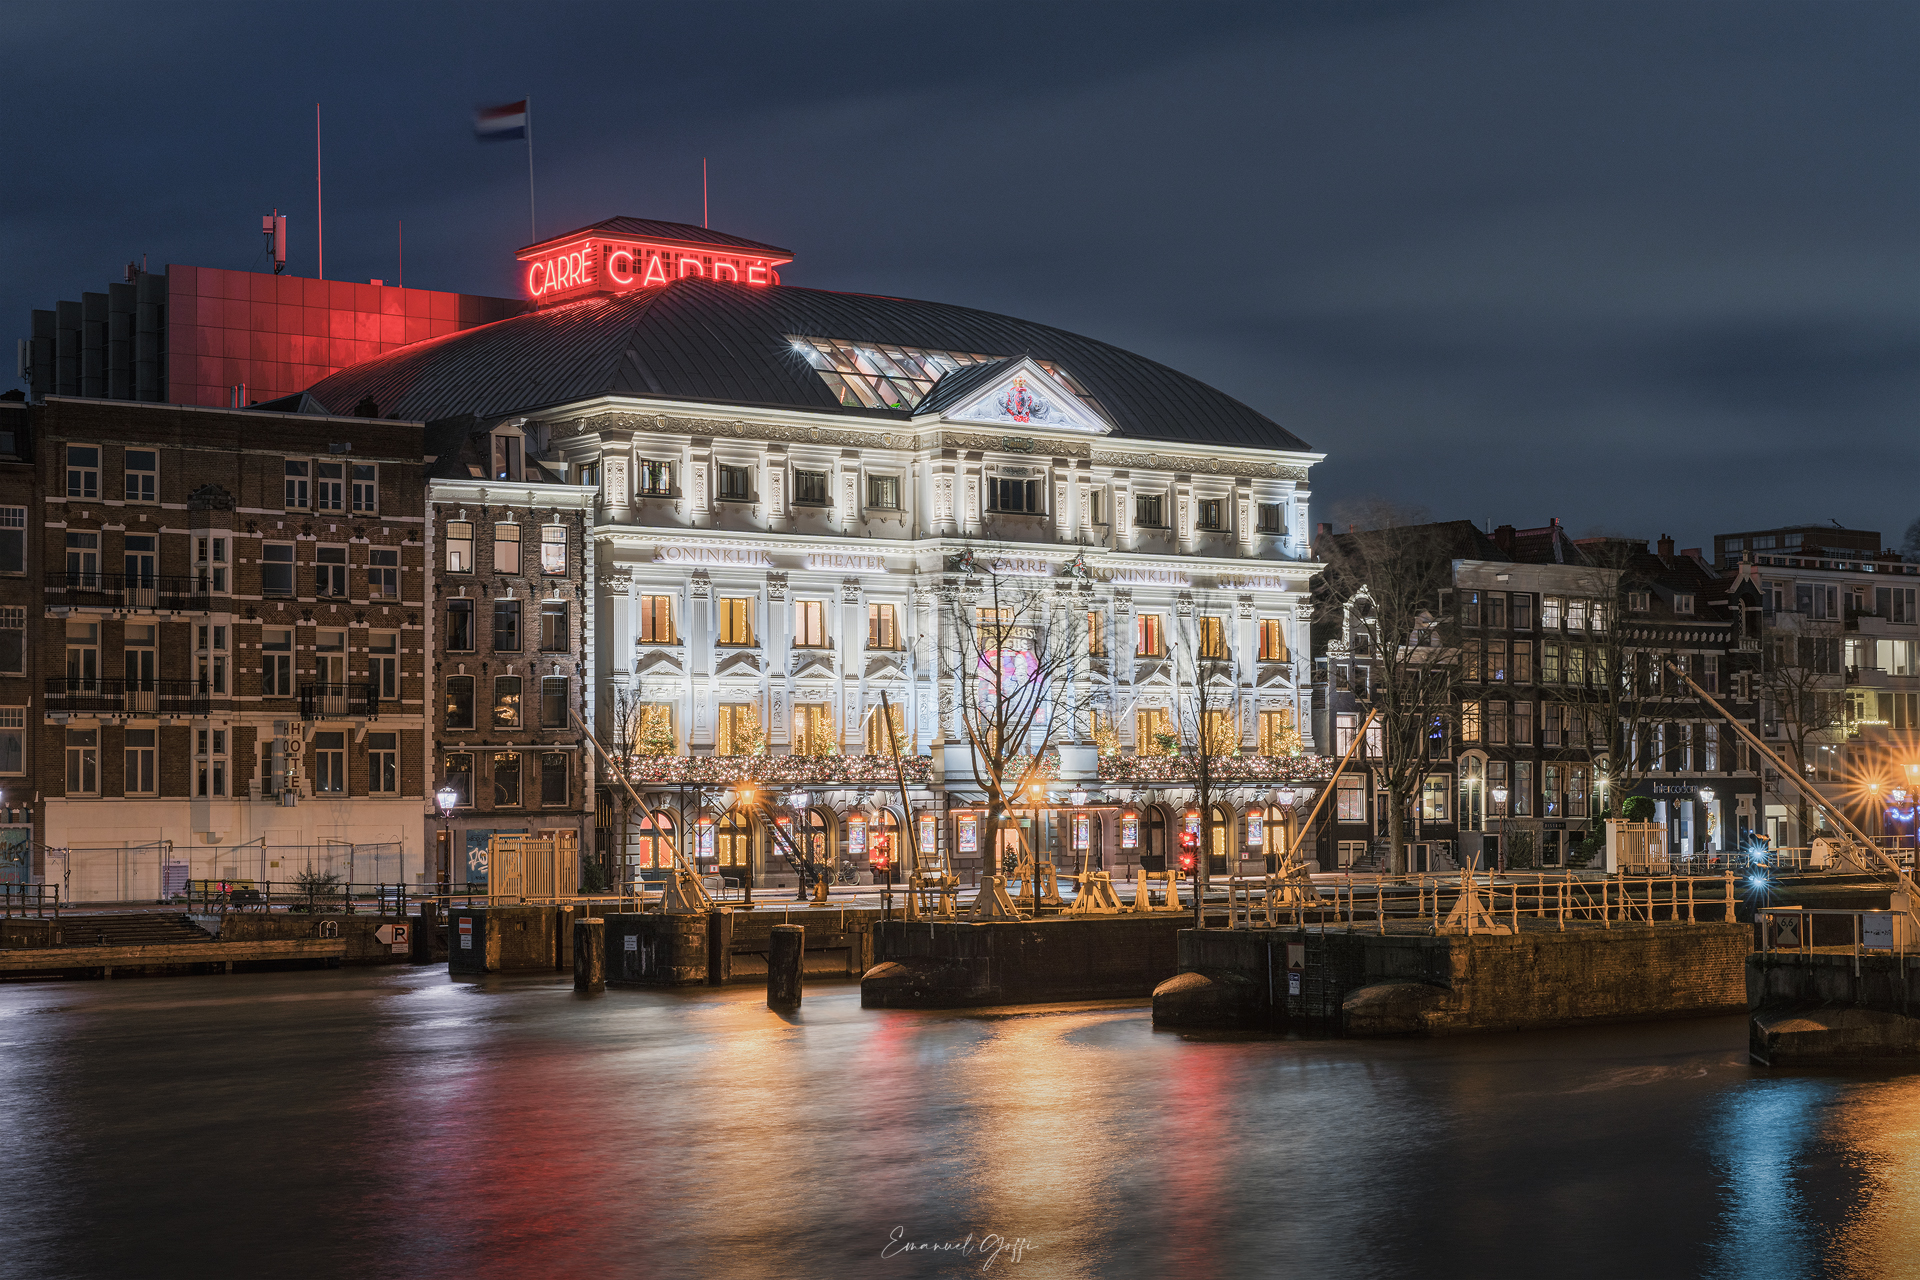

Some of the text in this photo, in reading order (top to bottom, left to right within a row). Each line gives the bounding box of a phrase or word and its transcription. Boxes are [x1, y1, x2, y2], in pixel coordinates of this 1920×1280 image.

[529, 242, 592, 296] CARRÉ
[653, 544, 888, 571] KONINKLIJK THEATER
[1091, 566, 1283, 588] KONINKLIJK THEATER
[1781, 917, 1794, 928] 6,6
